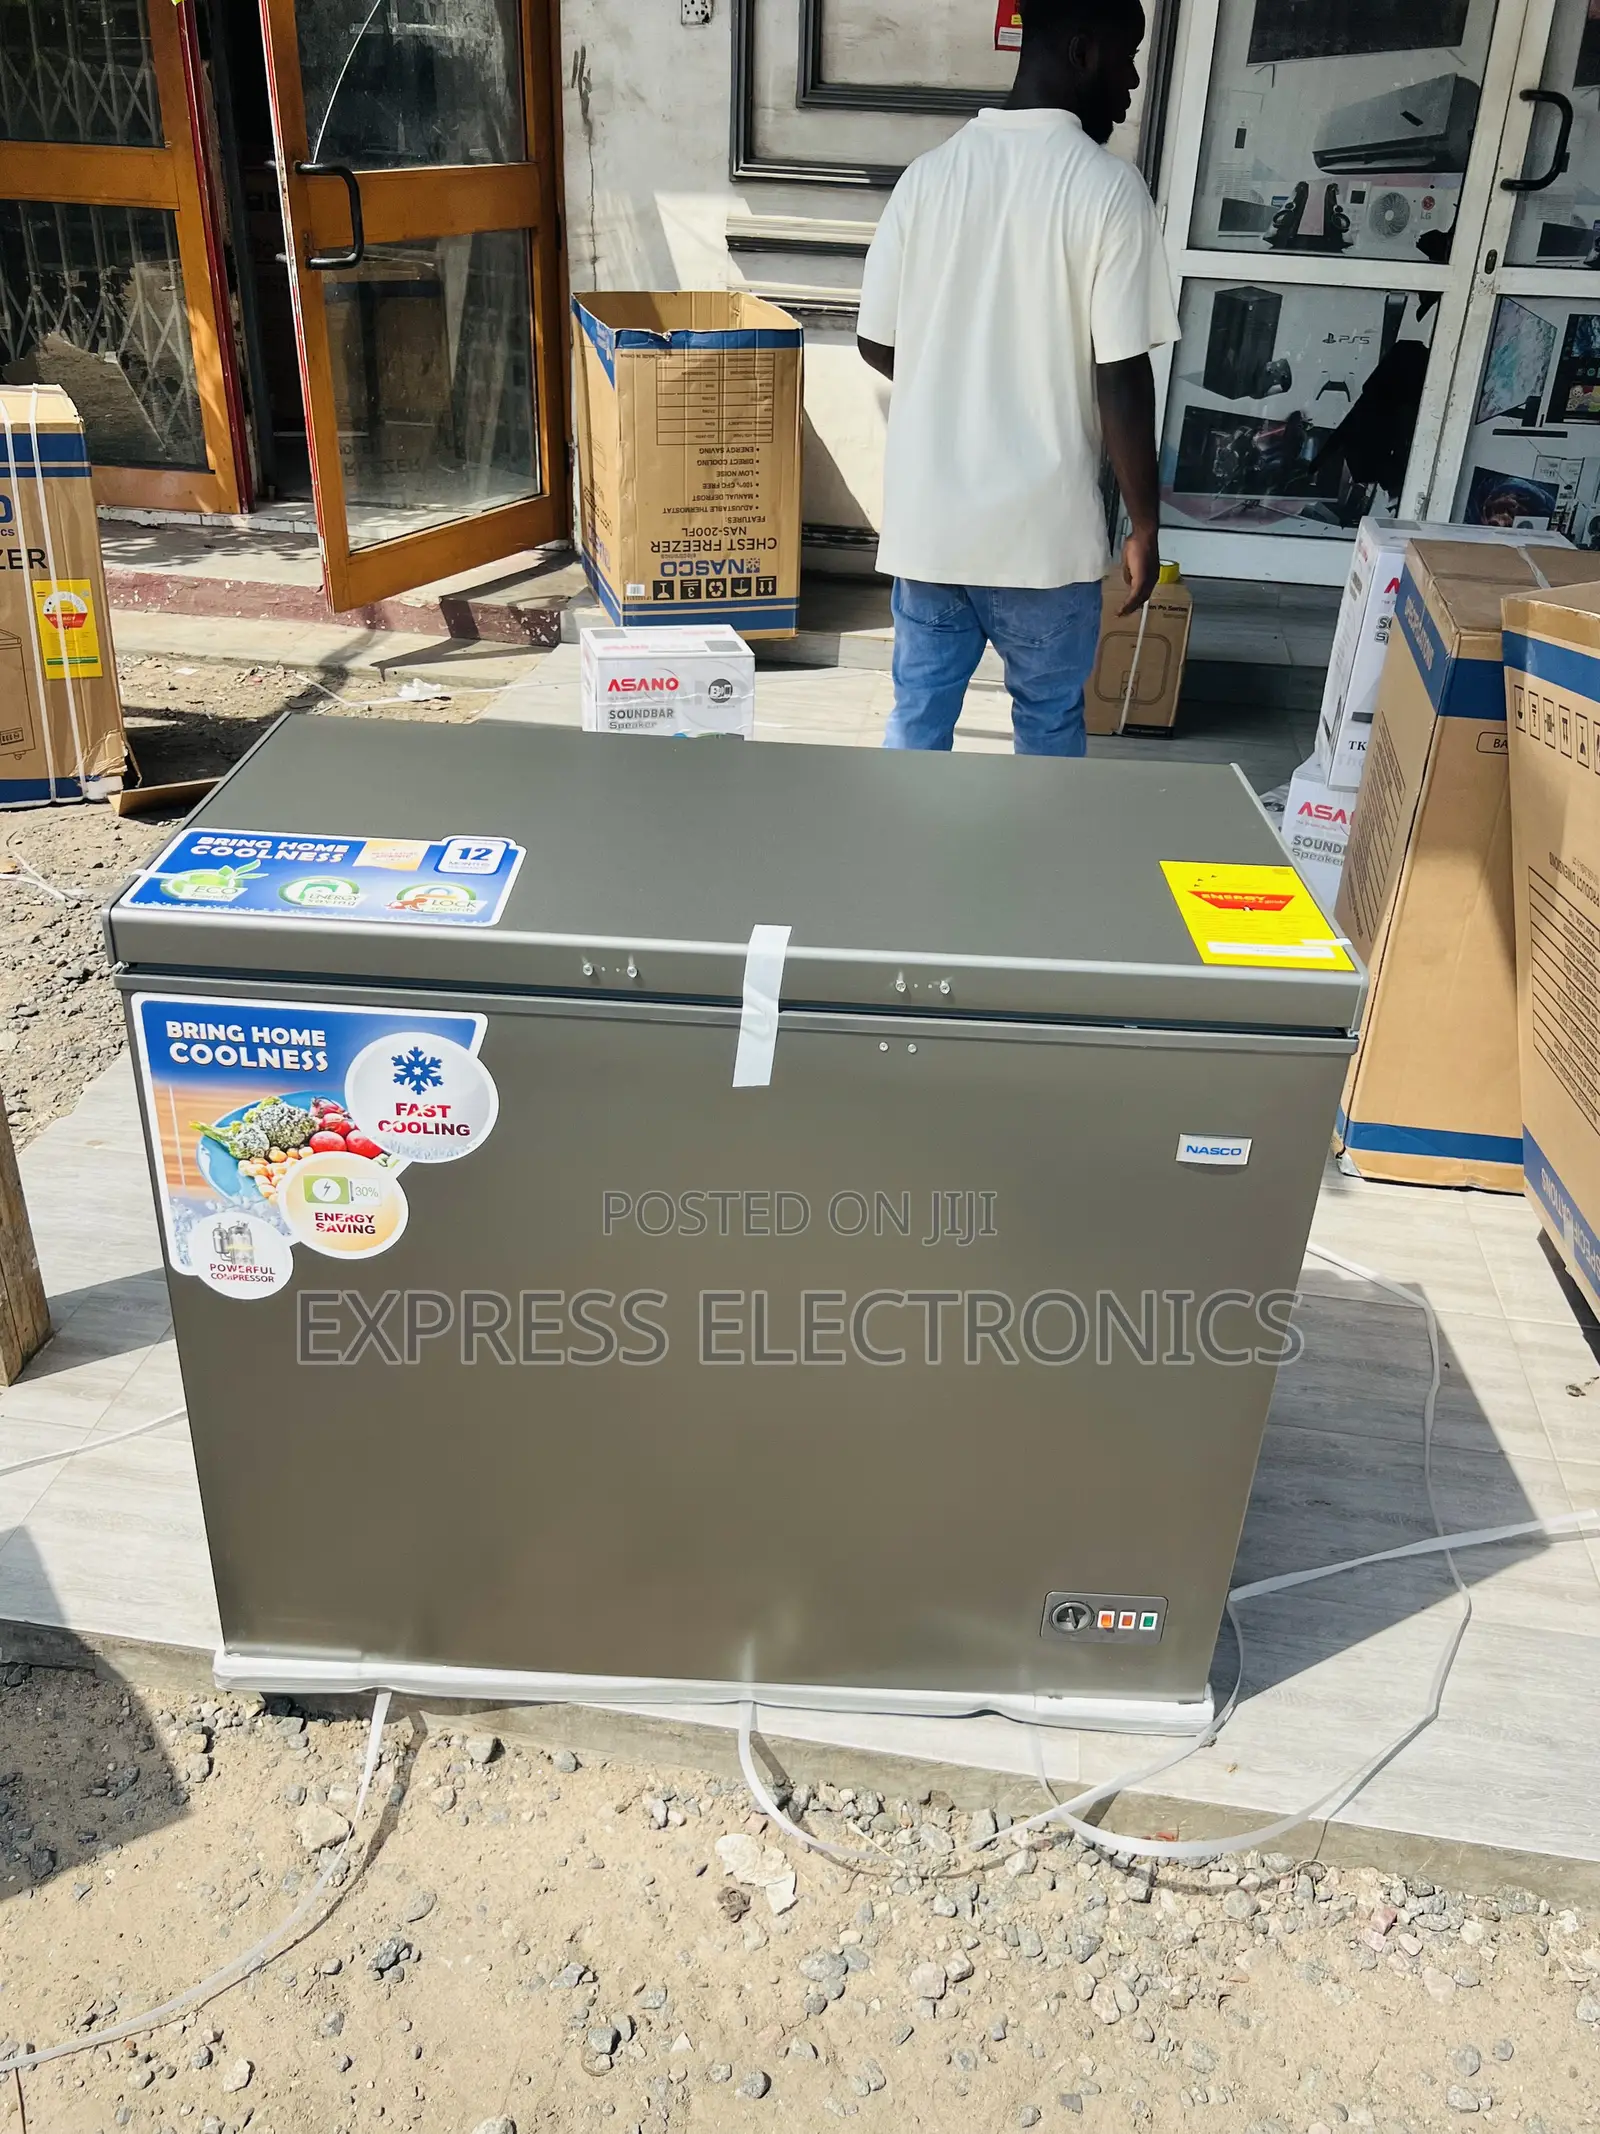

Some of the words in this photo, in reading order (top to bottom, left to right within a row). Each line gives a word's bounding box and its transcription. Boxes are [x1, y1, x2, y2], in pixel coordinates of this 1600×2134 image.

[1338, 335, 1370, 345] PS5
[663, 506, 708, 514] THERMOSTAT
[682, 526, 747, 536] NAS-200FL
[650, 539, 722, 553] FREEZER
[727, 537, 777, 551] CHEST
[661, 559, 744, 577] NASCO
[608, 677, 679, 692] ASANO
[609, 708, 674, 719] SOUNDBAR
[608, 721, 657, 729] Speaker
[196, 837, 273, 850] BRING
[277, 841, 351, 853] HOME
[1293, 835, 1346, 854] SOUND
[190, 846, 350, 863] COOLNESS
[457, 847, 493, 861] 12
[194, 886, 239, 895] ECO
[432, 899, 477, 907] LOCK
[1201, 893, 1266, 903] ENERGY
[166, 1020, 245, 1042] BRING
[252, 1026, 327, 1047] HOME
[169, 1042, 328, 1072] COOLNESS
[395, 1102, 452, 1119] FAST
[378, 1119, 471, 1137] COOLING
[1186, 1145, 1241, 1156] NASCO
[354, 1185, 379, 1199] 30%
[314, 1212, 375, 1224] ENERGY
[315, 1222, 376, 1235] SAVING
[209, 1263, 276, 1275] POWERFUL
[210, 1272, 275, 1283] COMPRESSOR
